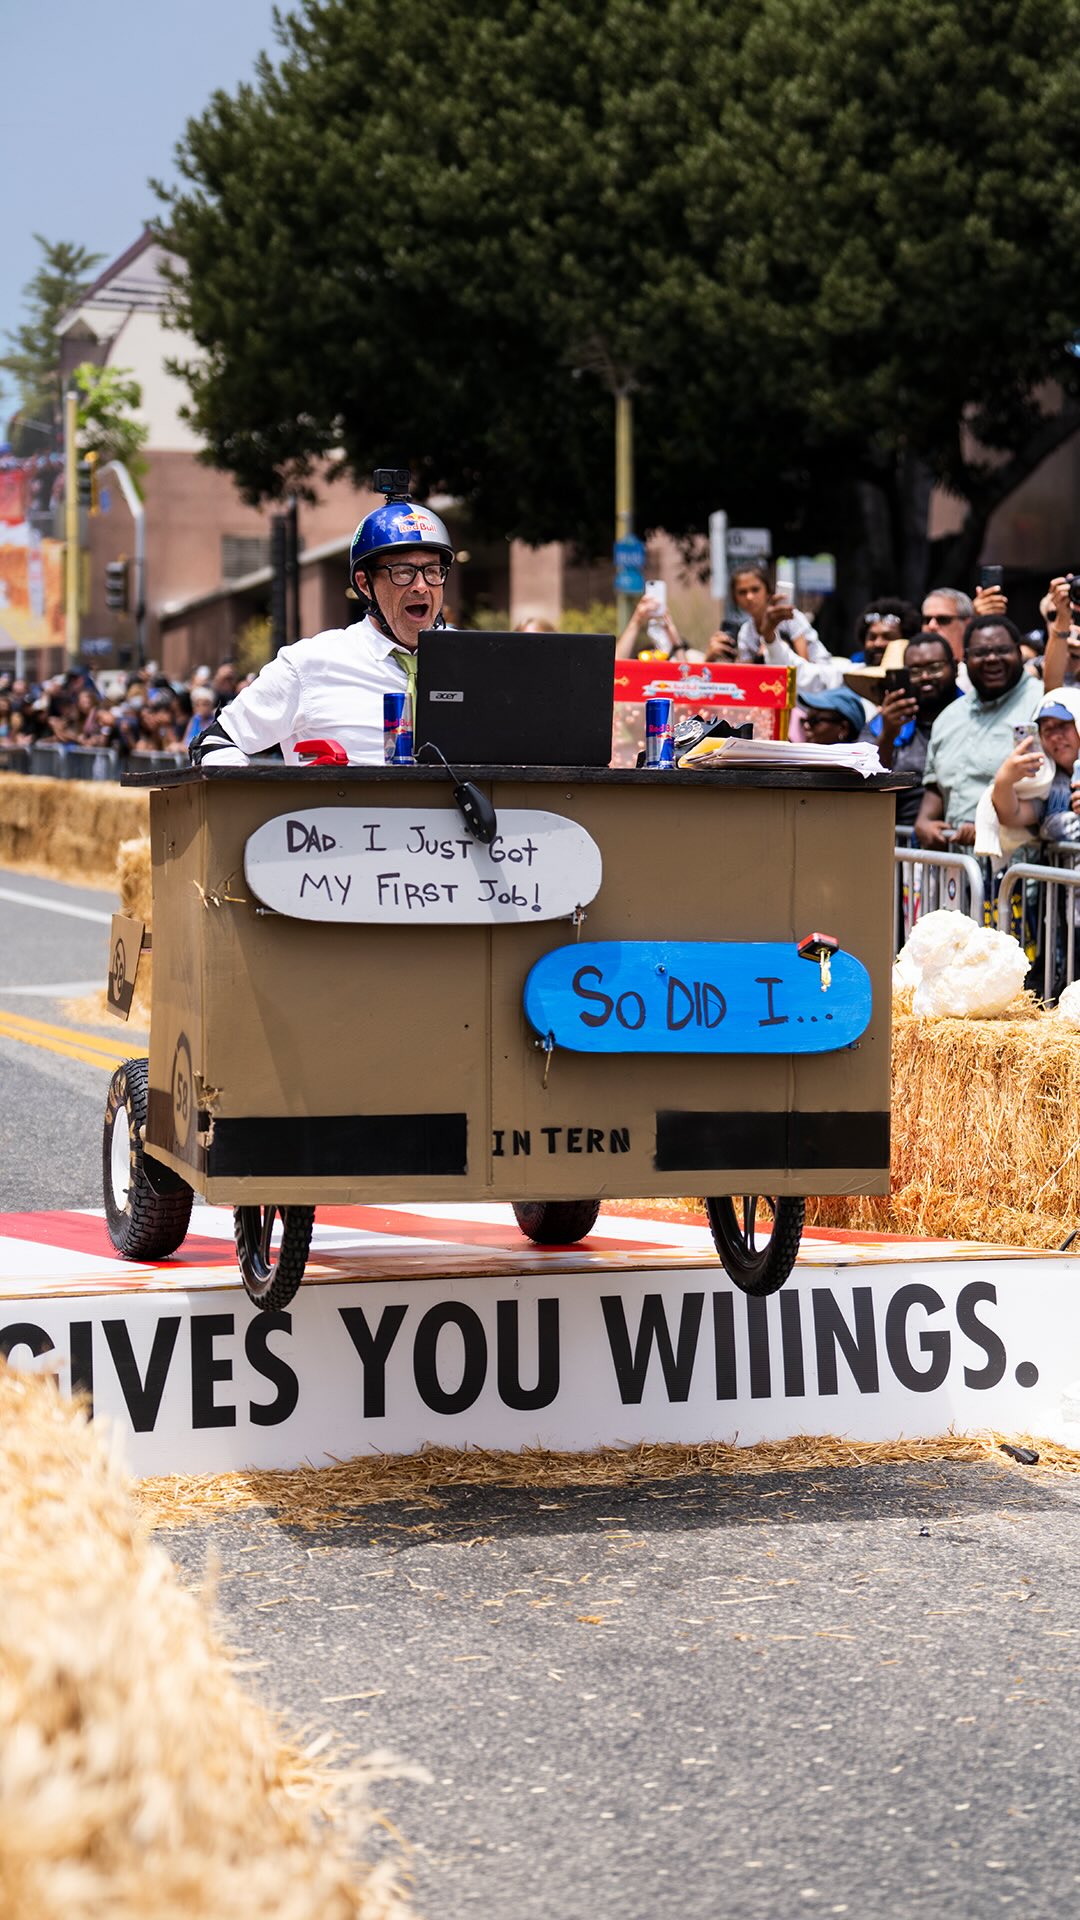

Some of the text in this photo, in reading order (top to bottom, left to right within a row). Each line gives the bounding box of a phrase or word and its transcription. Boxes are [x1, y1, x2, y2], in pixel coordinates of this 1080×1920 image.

[399, 522, 437, 532] Red Bull
[435, 692, 457, 700] acer
[649, 724, 664, 733] Red
[363, 824, 387, 851] I
[299, 873, 351, 905] MY
[377, 873, 459, 910] FIRST
[667, 976, 727, 1031] DID
[338, 1298, 560, 1418] YOU
[600, 1281, 1039, 1405] WIIINGS.
